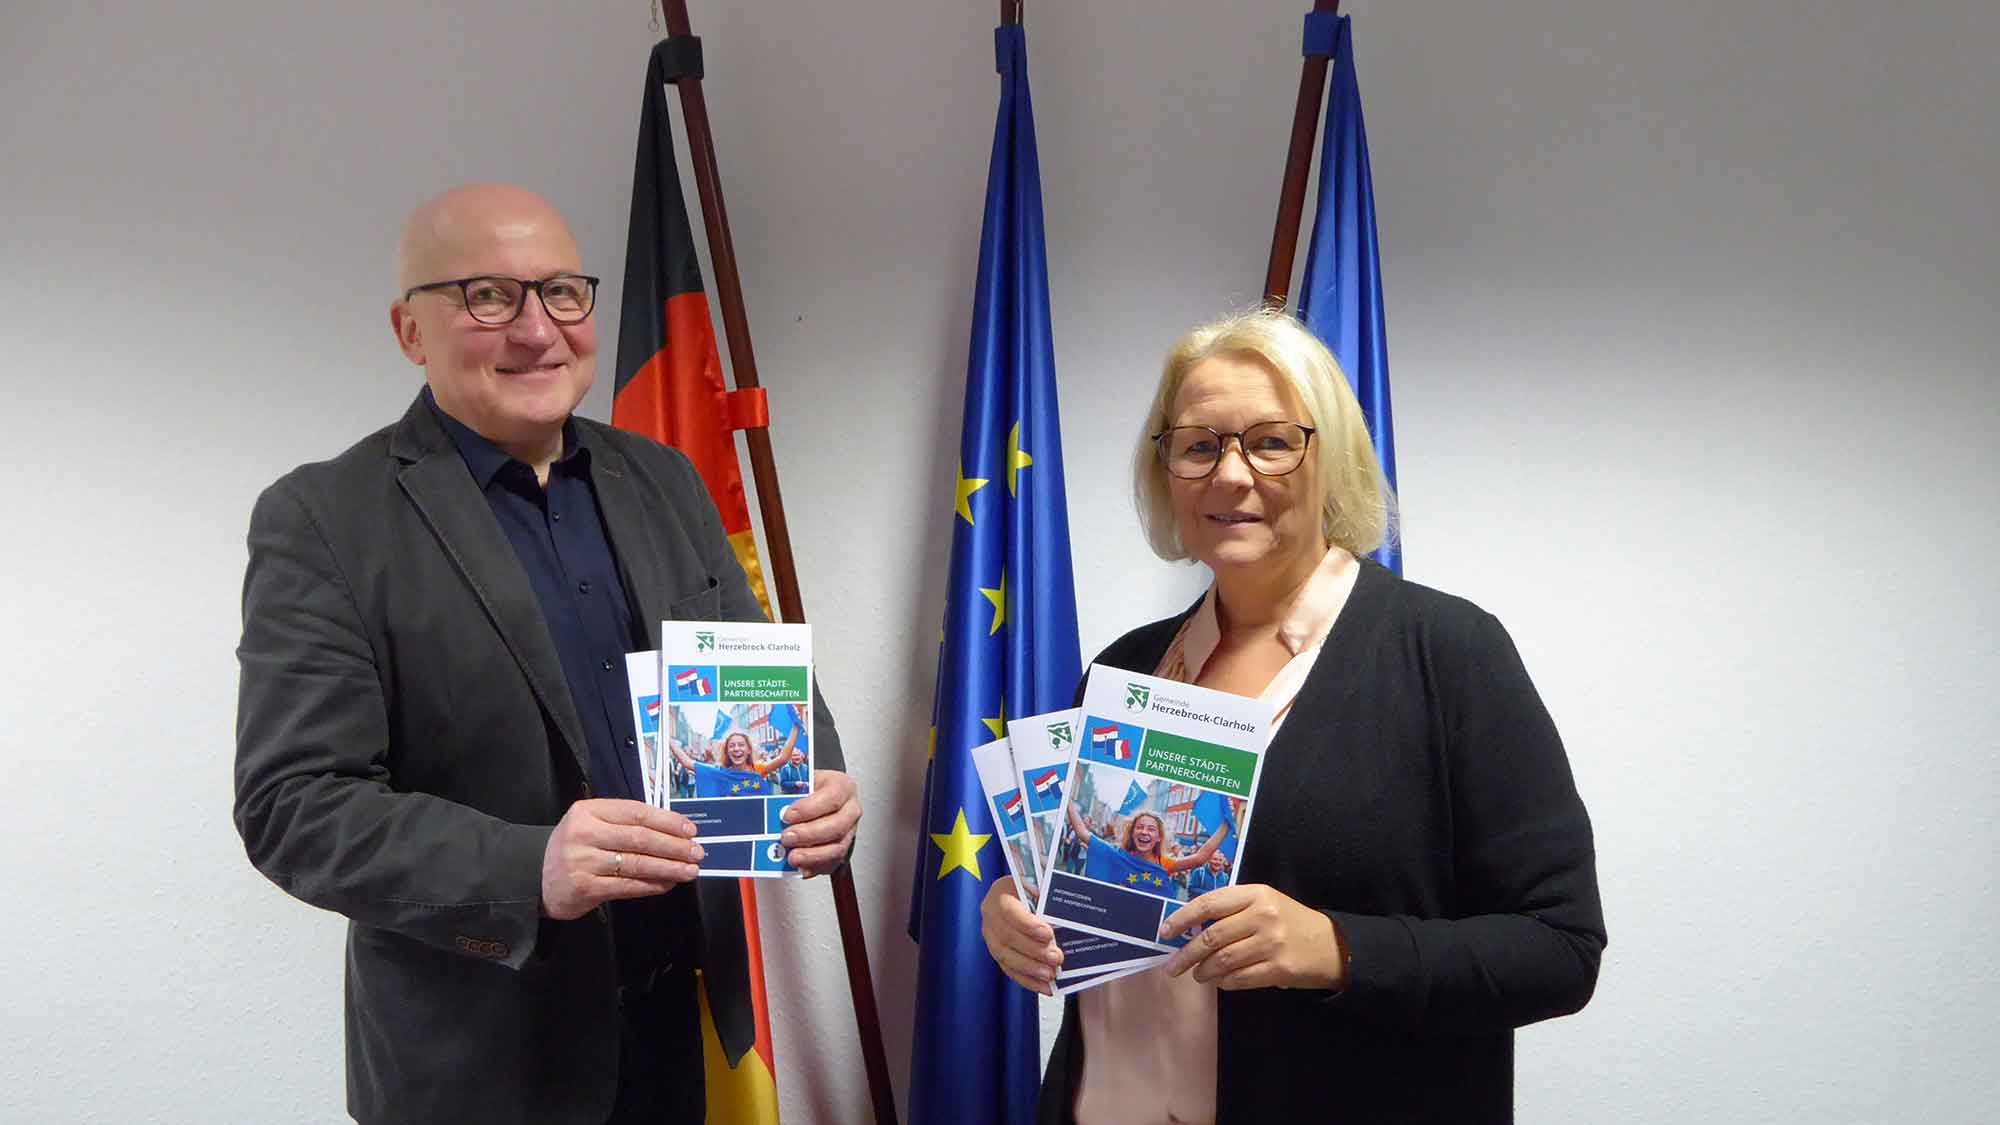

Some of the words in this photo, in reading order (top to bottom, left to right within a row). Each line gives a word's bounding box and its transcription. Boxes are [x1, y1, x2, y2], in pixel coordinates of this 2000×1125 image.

[724, 679, 755, 688] UNSERE
[724, 689, 800, 698] PARTNERSCHAFTEN
[1151, 702, 1256, 733] Herzebrock-Clarholz
[1147, 747, 1187, 763] UNSERE
[1145, 760, 1241, 790] PARTNERSCHAFTEN
